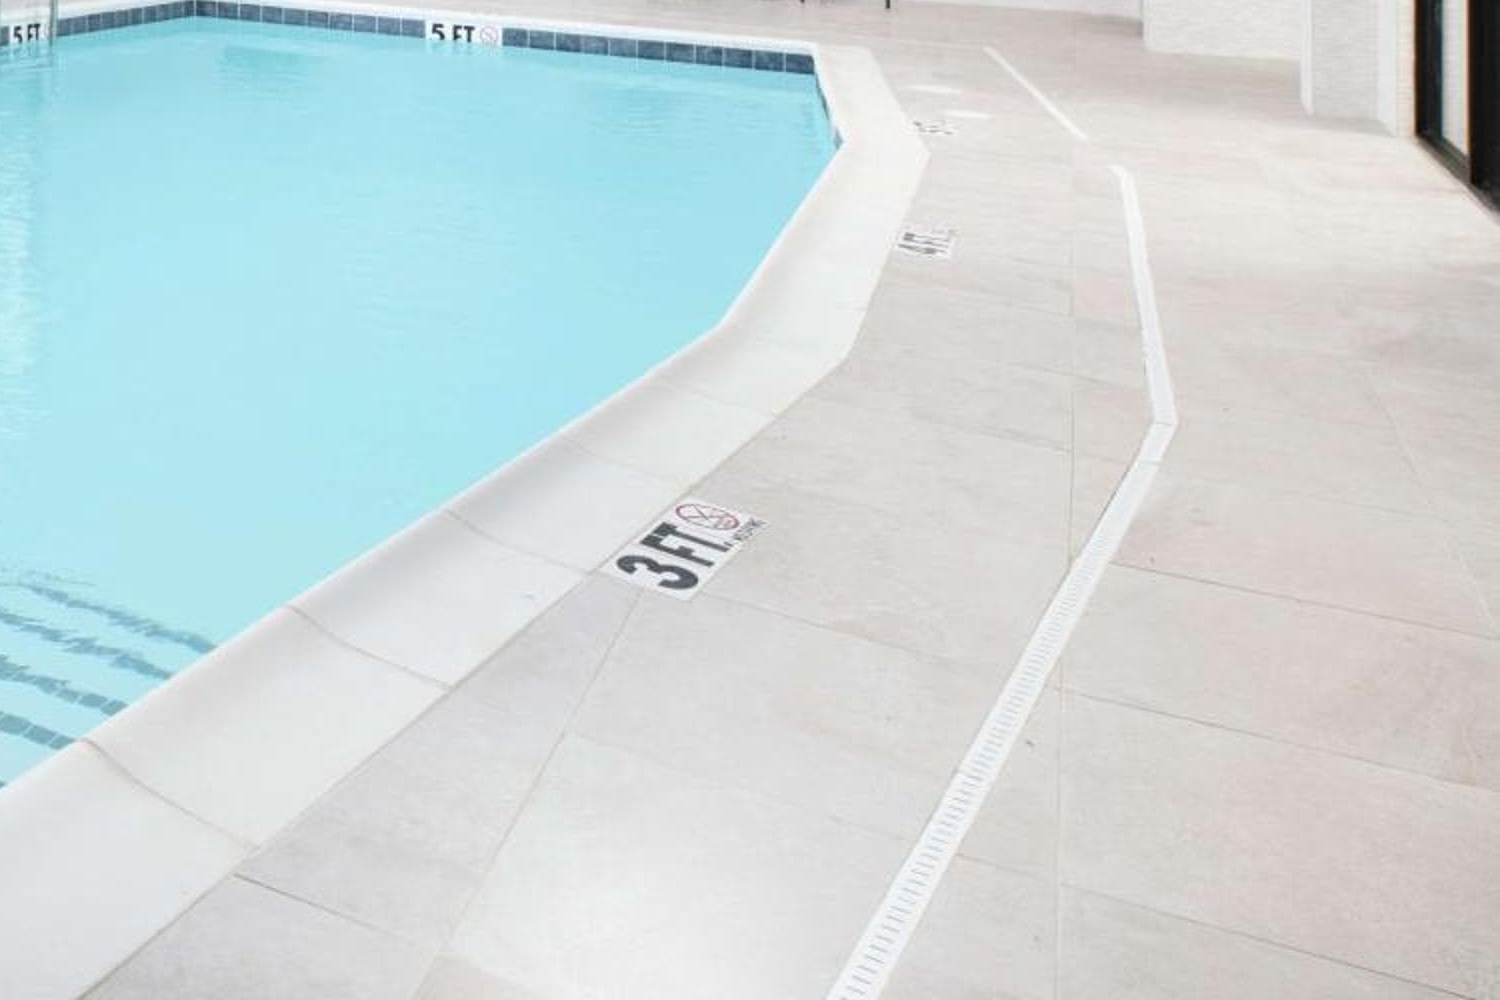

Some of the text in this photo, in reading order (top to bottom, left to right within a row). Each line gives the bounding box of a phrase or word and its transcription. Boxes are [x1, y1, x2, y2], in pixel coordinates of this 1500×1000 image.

[14, 24, 41, 43] 5 FT
[432, 23, 475, 43] 5 FT
[617, 555, 698, 589] 3
